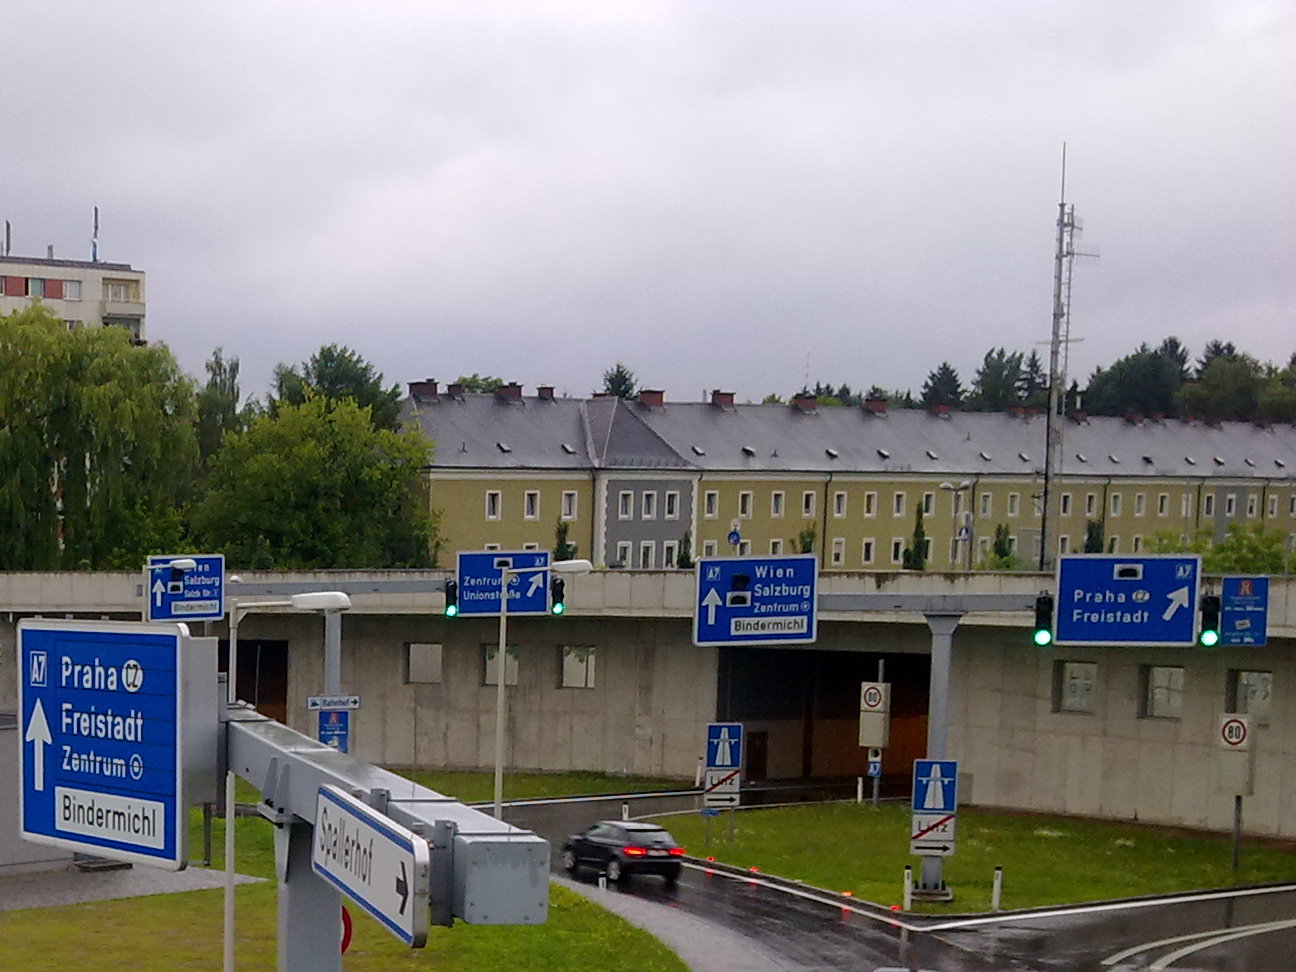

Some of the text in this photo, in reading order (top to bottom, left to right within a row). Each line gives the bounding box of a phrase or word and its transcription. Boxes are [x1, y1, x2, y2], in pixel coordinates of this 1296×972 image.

[707, 567, 720, 579] A7
[755, 566, 794, 578] Wien
[1177, 565, 1191, 577] A7
[184, 575, 219, 586] Salzburg
[754, 584, 811, 598] Salzburg
[1074, 589, 1126, 602] Praha
[754, 603, 799, 613] Zentrum
[1073, 609, 1149, 622] Freistadt
[734, 619, 804, 631] Bindermichl
[31, 655, 46, 683] A7
[61, 656, 139, 691] Praha CZ
[61, 703, 144, 742] Freistadt
[1228, 725, 1241, 739] 80
[62, 745, 126, 778] Zentrum
[62, 794, 156, 837] Bindermichl
[319, 806, 373, 886] Spallerhof
